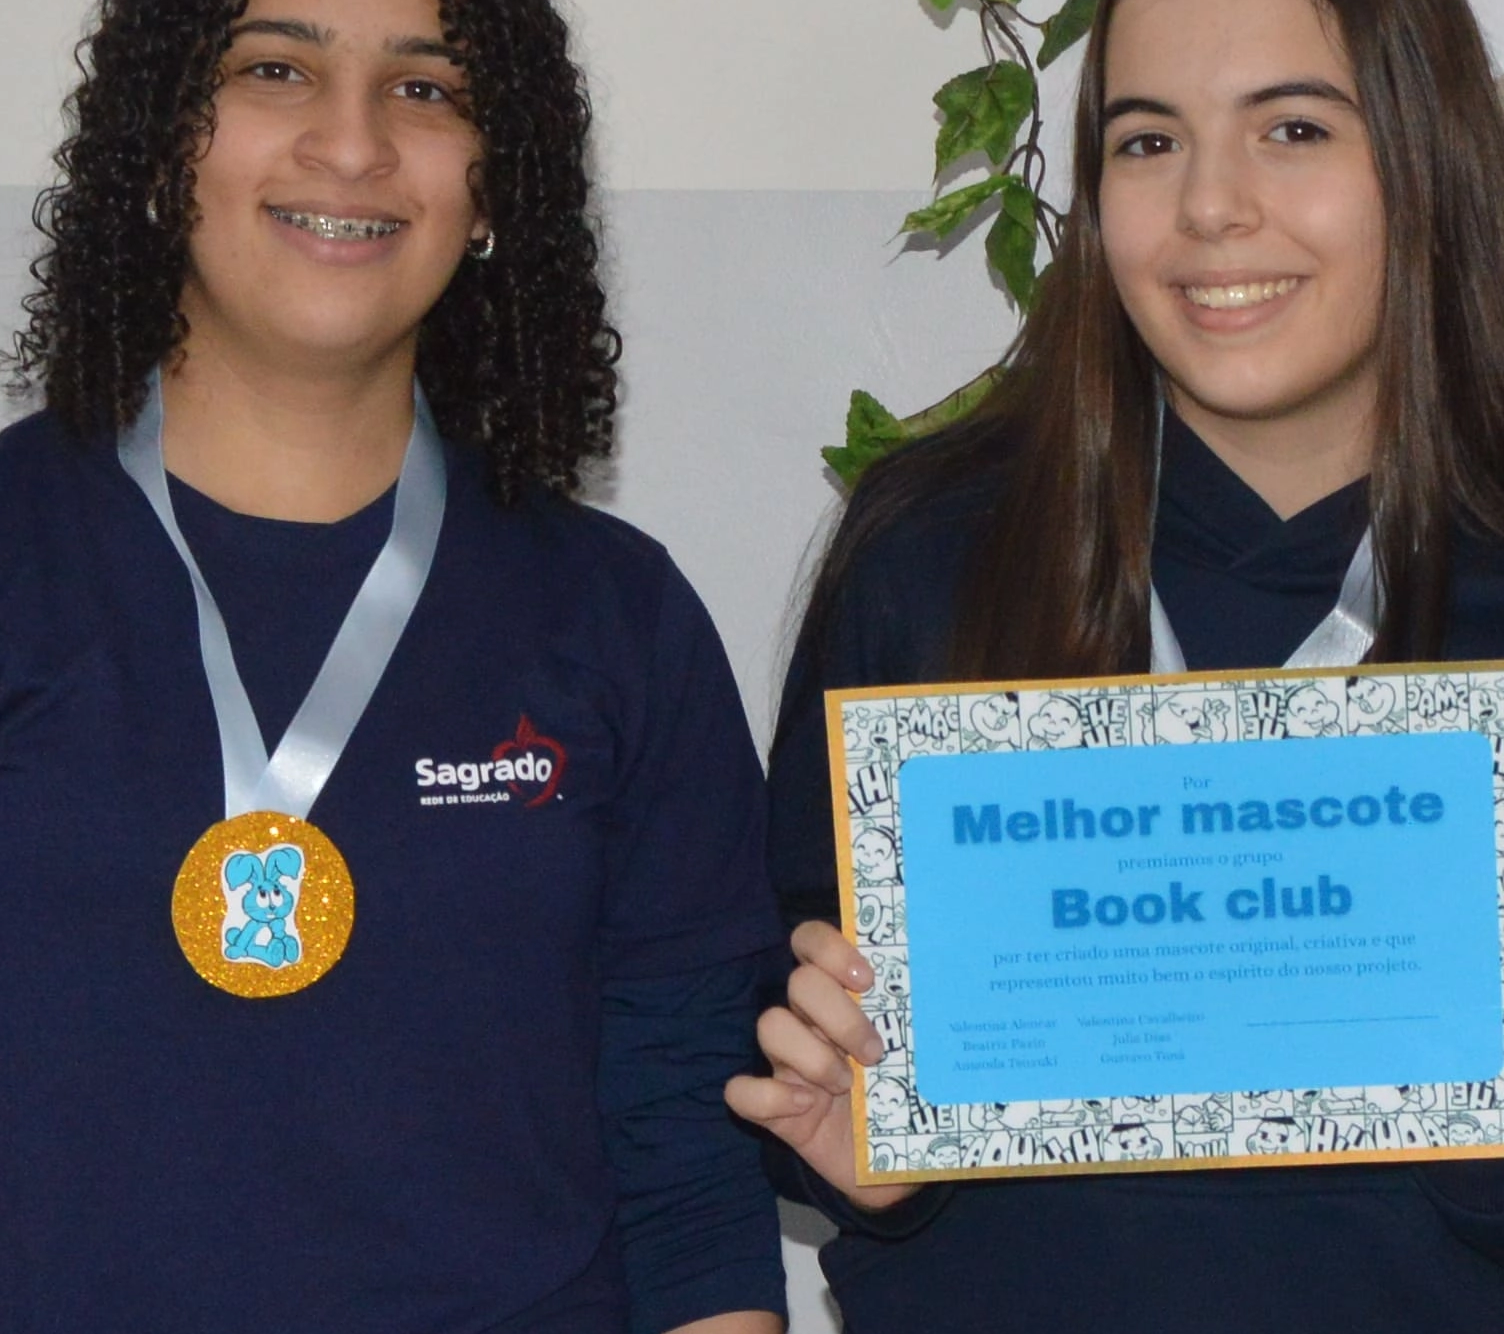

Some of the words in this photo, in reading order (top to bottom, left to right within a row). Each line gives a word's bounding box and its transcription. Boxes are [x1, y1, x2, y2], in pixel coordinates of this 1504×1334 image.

[415, 752, 552, 791] Sagrado
[1183, 776, 1212, 790] Por
[420, 797, 444, 806] REDE
[446, 795, 459, 804] DE
[461, 791, 510, 804] EDUCAÇÃO
[953, 798, 1161, 844] Melhor
[1182, 785, 1445, 835] mascote
[1118, 855, 1213, 873] premiamos
[1218, 855, 1229, 865] o
[1233, 849, 1283, 868] grupo
[1051, 882, 1205, 929] Book
[1226, 875, 1353, 922] club
[993, 952, 1022, 967] por
[1027, 951, 1051, 963] ter
[1055, 945, 1109, 961] criado
[1113, 946, 1150, 958] uma
[1155, 941, 1225, 956] mascote
[1303, 934, 1367, 949] criativa
[1371, 936, 1382, 947] e
[1385, 933, 1416, 949] que
[990, 975, 1093, 993] representou
[1098, 970, 1149, 986] muito
[1152, 968, 1190, 983] bem
[1194, 970, 1205, 981] o
[1209, 965, 1274, 983] espírito
[1278, 962, 1300, 977] do
[1304, 963, 1352, 976] nosso
[1356, 957, 1422, 978] projeto.
